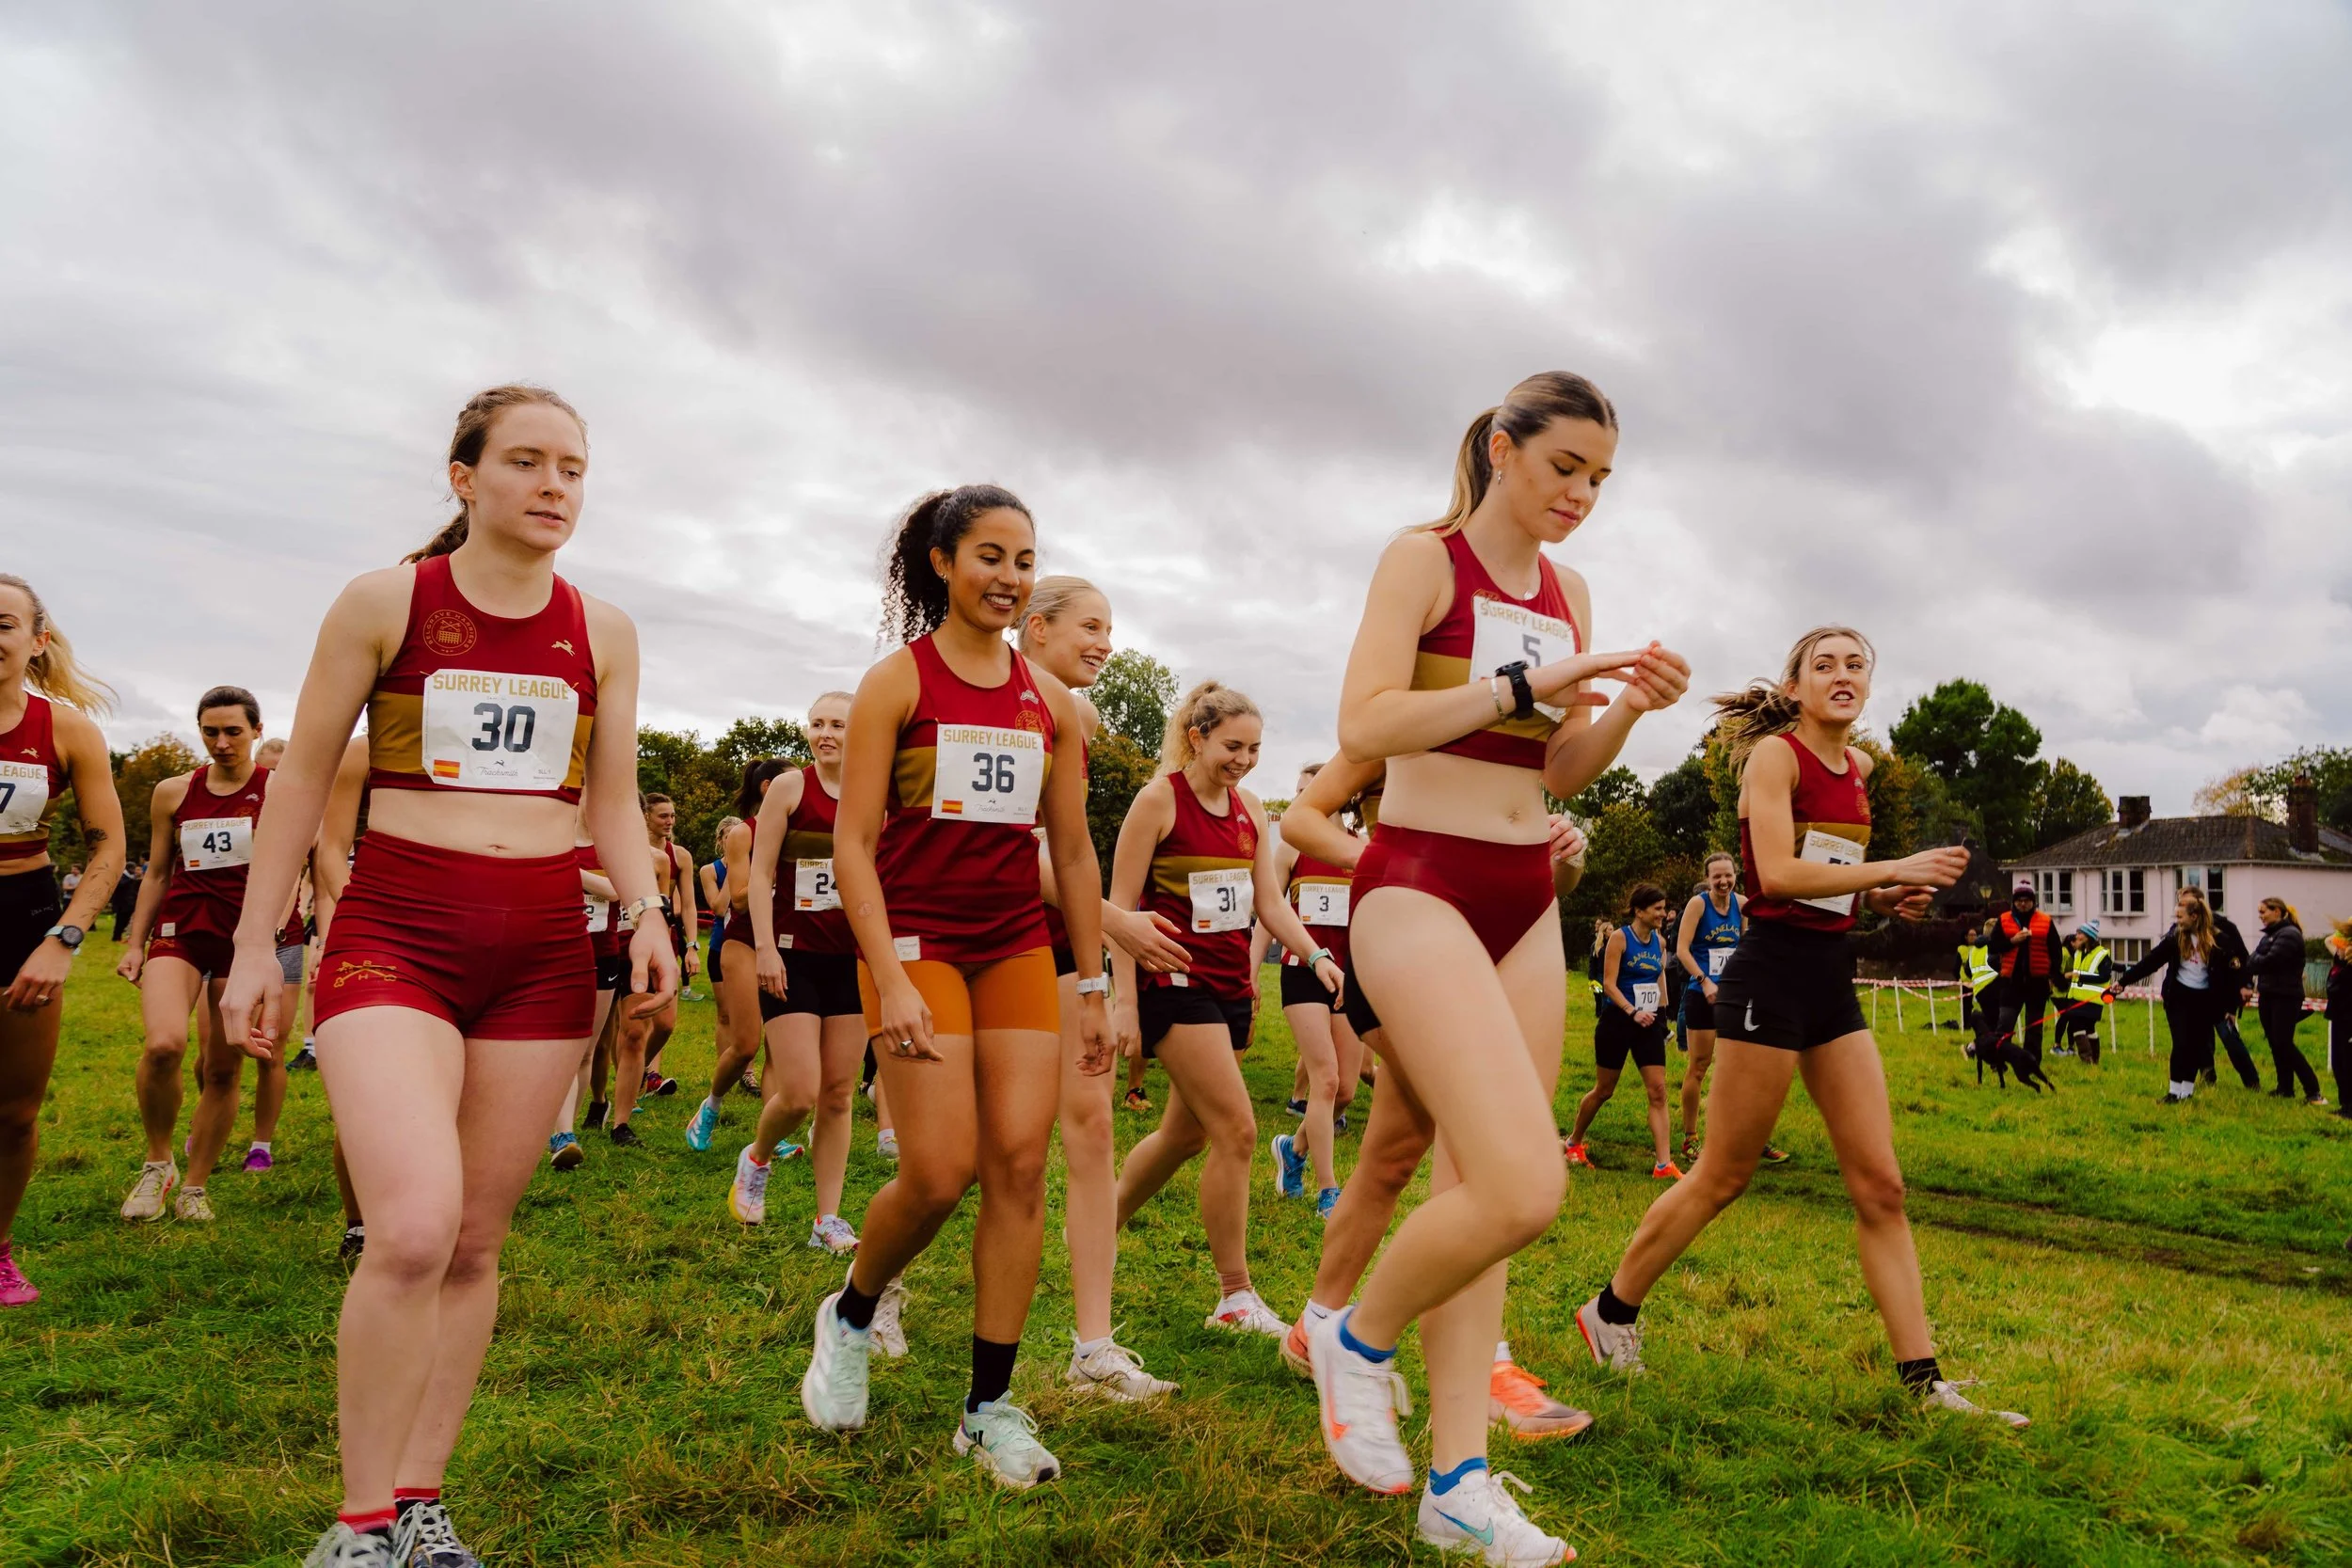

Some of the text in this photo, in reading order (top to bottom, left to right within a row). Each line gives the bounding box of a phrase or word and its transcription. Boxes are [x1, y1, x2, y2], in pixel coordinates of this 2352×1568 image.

[1481, 602, 1528, 626] SURREY
[426, 611, 474, 648] BELGRAVE HARRIERS
[1522, 633, 1541, 668] 5
[433, 673, 569, 700] SURREY LEAGUE
[472, 702, 536, 752] 30
[944, 729, 1039, 750] SURREY LEAGUE
[972, 752, 1015, 793] 36
[184, 818, 247, 832] SURREY LEAGUE
[202, 831, 233, 853] 43
[799, 860, 829, 869] SURREY
[1192, 871, 1249, 885] SURREY LEAGUE
[1216, 886, 1236, 912] 31
[1319, 895, 1329, 912] 3
[1642, 991, 1658, 1005] 707
